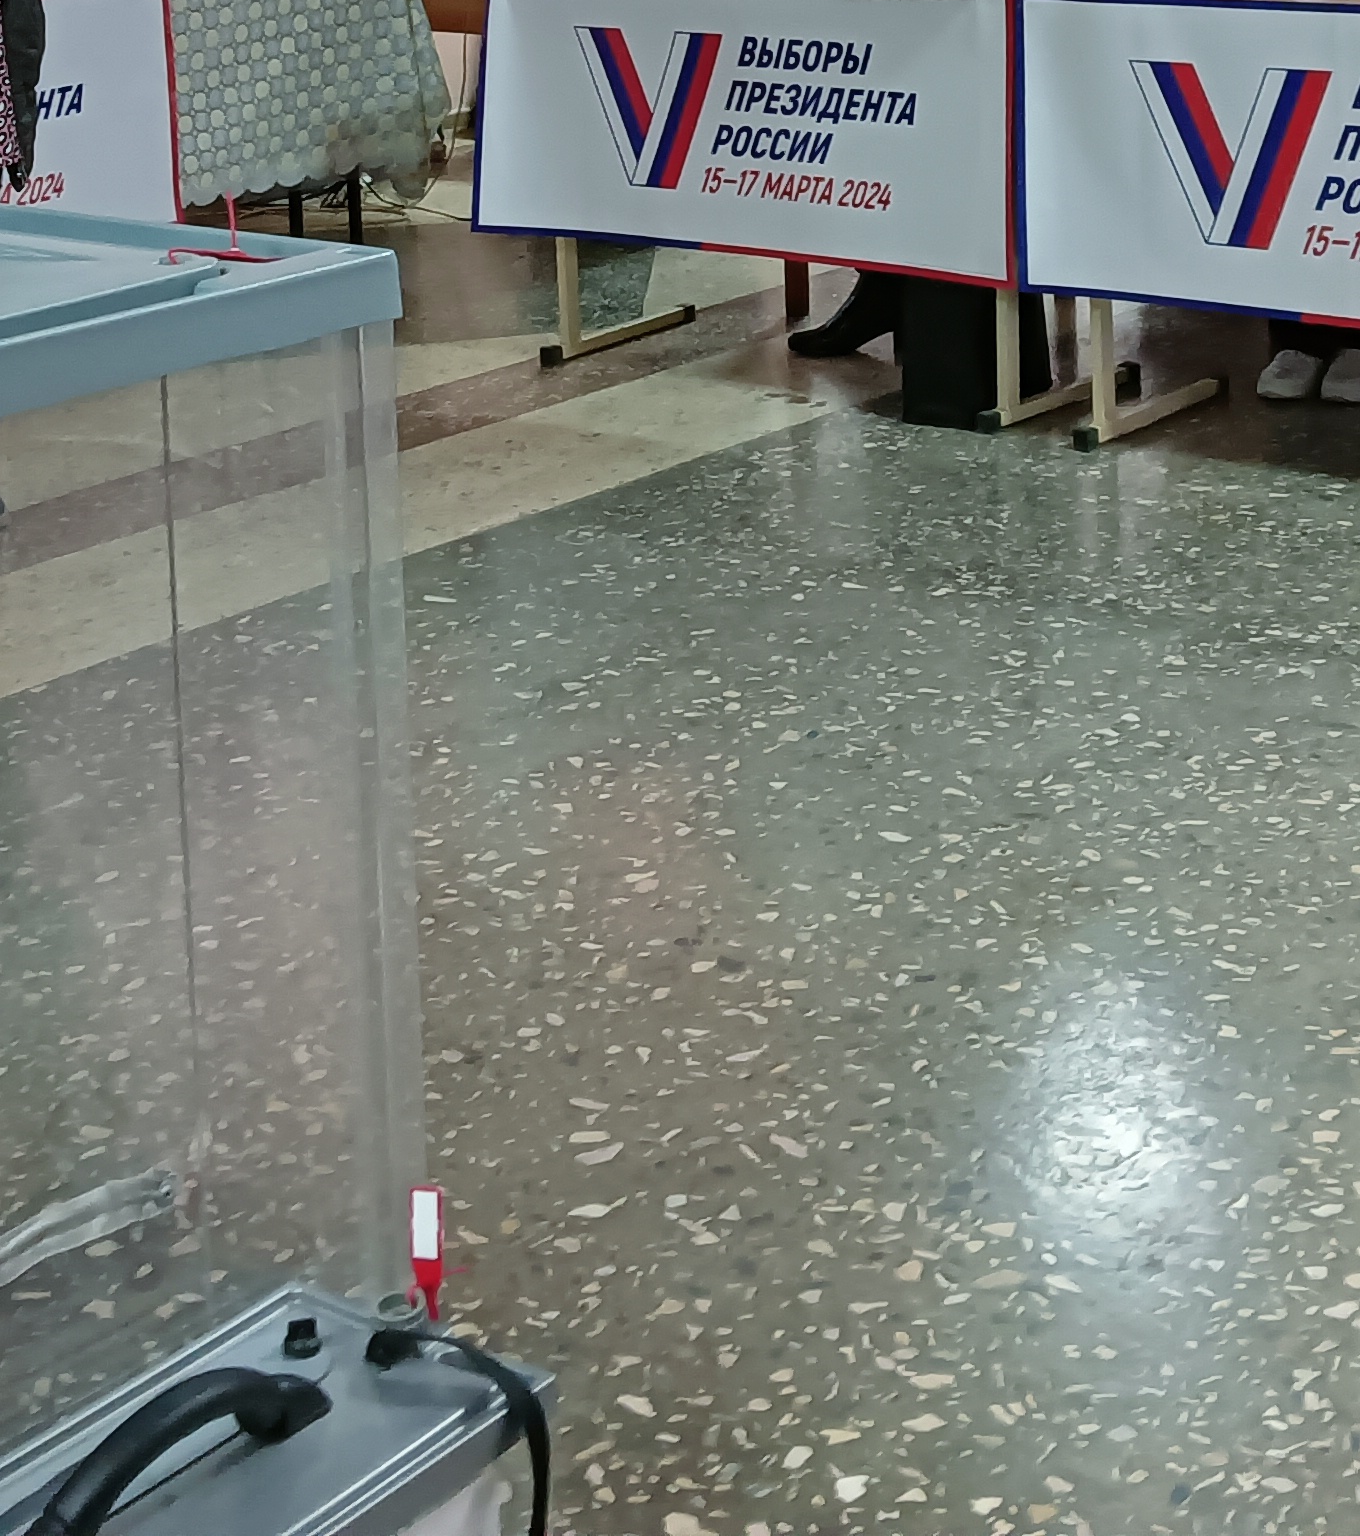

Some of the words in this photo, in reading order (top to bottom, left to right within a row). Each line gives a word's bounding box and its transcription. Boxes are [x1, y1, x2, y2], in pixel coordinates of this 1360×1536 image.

[736, 36, 873, 75] ВЫБОРЫ
[725, 80, 918, 126] ПРЕЗИДЕНТА
[711, 125, 834, 165] РОССИИ
[16, 171, 65, 205] 2024
[761, 172, 835, 205] МАРТА
[838, 180, 892, 211] 2024
